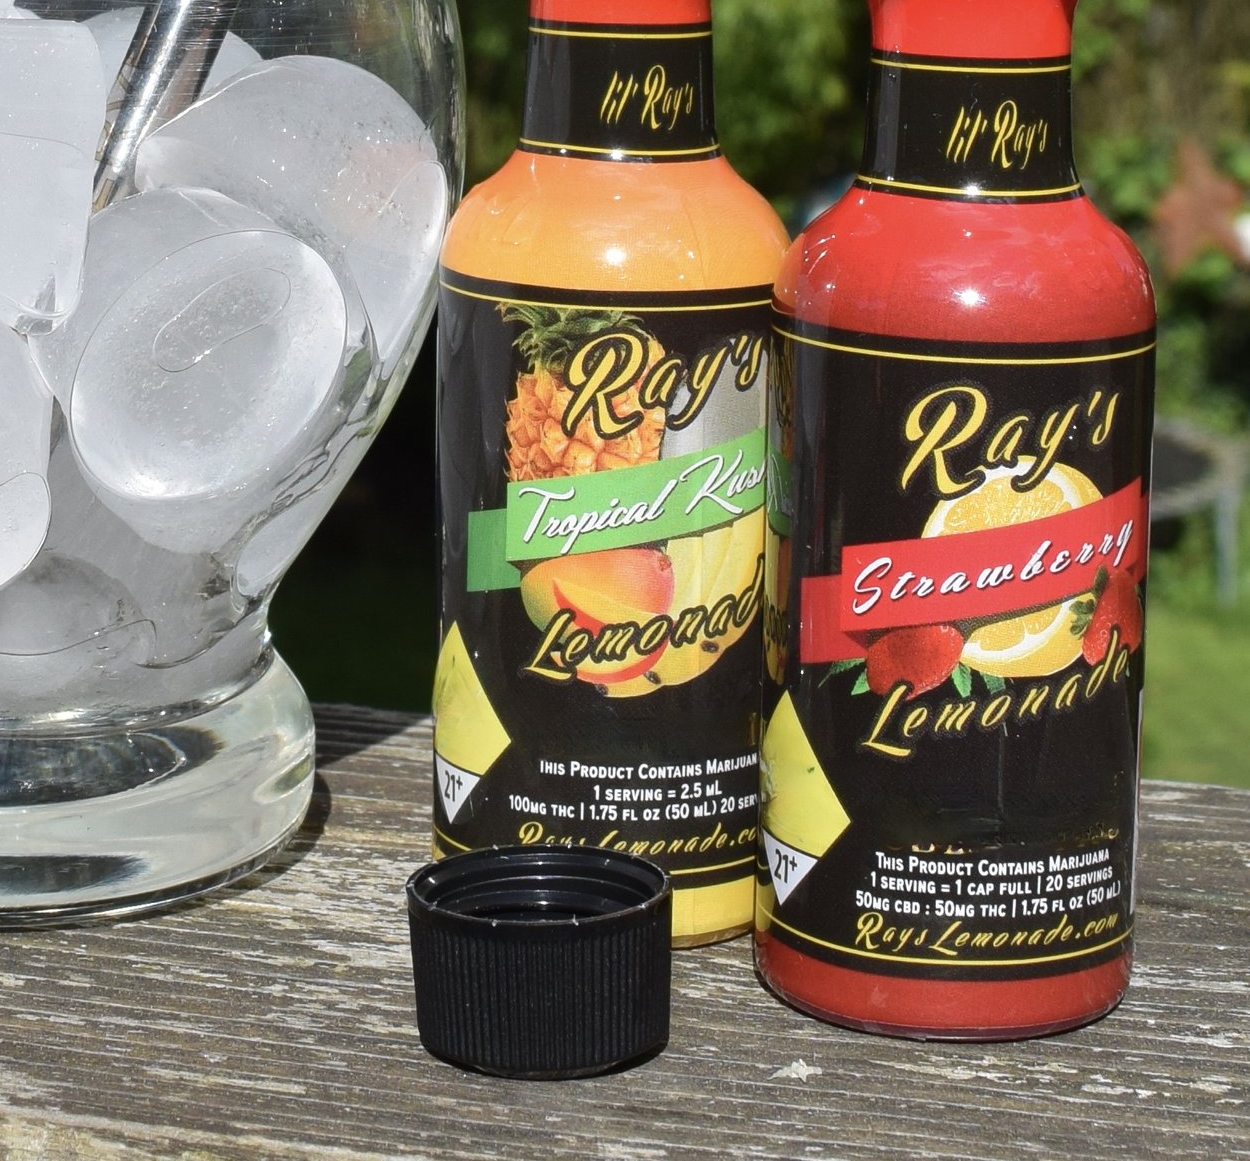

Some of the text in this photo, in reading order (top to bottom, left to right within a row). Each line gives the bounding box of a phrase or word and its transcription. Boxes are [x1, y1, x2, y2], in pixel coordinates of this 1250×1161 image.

[640, 63, 694, 131] Ray's
[991, 99, 1049, 171] Ray's
[562, 329, 765, 438] Ray's
[900, 385, 1120, 495] Ray's
[518, 478, 677, 555] Tropical
[852, 518, 1134, 616] Strawberry
[523, 554, 765, 681] Lemonad
[862, 629, 1128, 757] Lemonade
[593, 784, 601, 801] 1
[604, 787, 663, 802] SERVING
[667, 789, 677, 799] =
[680, 782, 703, 800] 2.5
[706, 752, 758, 775] MARIJUAN
[551, 804, 576, 819] THC
[589, 804, 619, 822] 1.75
[622, 808, 639, 822] FL
[642, 808, 661, 822] OZ
[665, 803, 690, 821] (50
[720, 796, 736, 815] 20
[870, 870, 877, 888] 1
[880, 875, 937, 894] SERVING
[940, 883, 951, 893] =
[955, 878, 962, 896] 1
[966, 882, 995, 896] CAP
[999, 882, 1032, 896] FULL
[1045, 874, 1063, 892] 20
[1066, 865, 1114, 889] SERVINGS
[894, 899, 921, 915] CBD
[979, 903, 1007, 918] THC
[1021, 897, 1049, 917] 1.75
[1052, 899, 1066, 914] FL
[1069, 895, 1084, 911] OZ
[1086, 886, 1104, 907] (50
